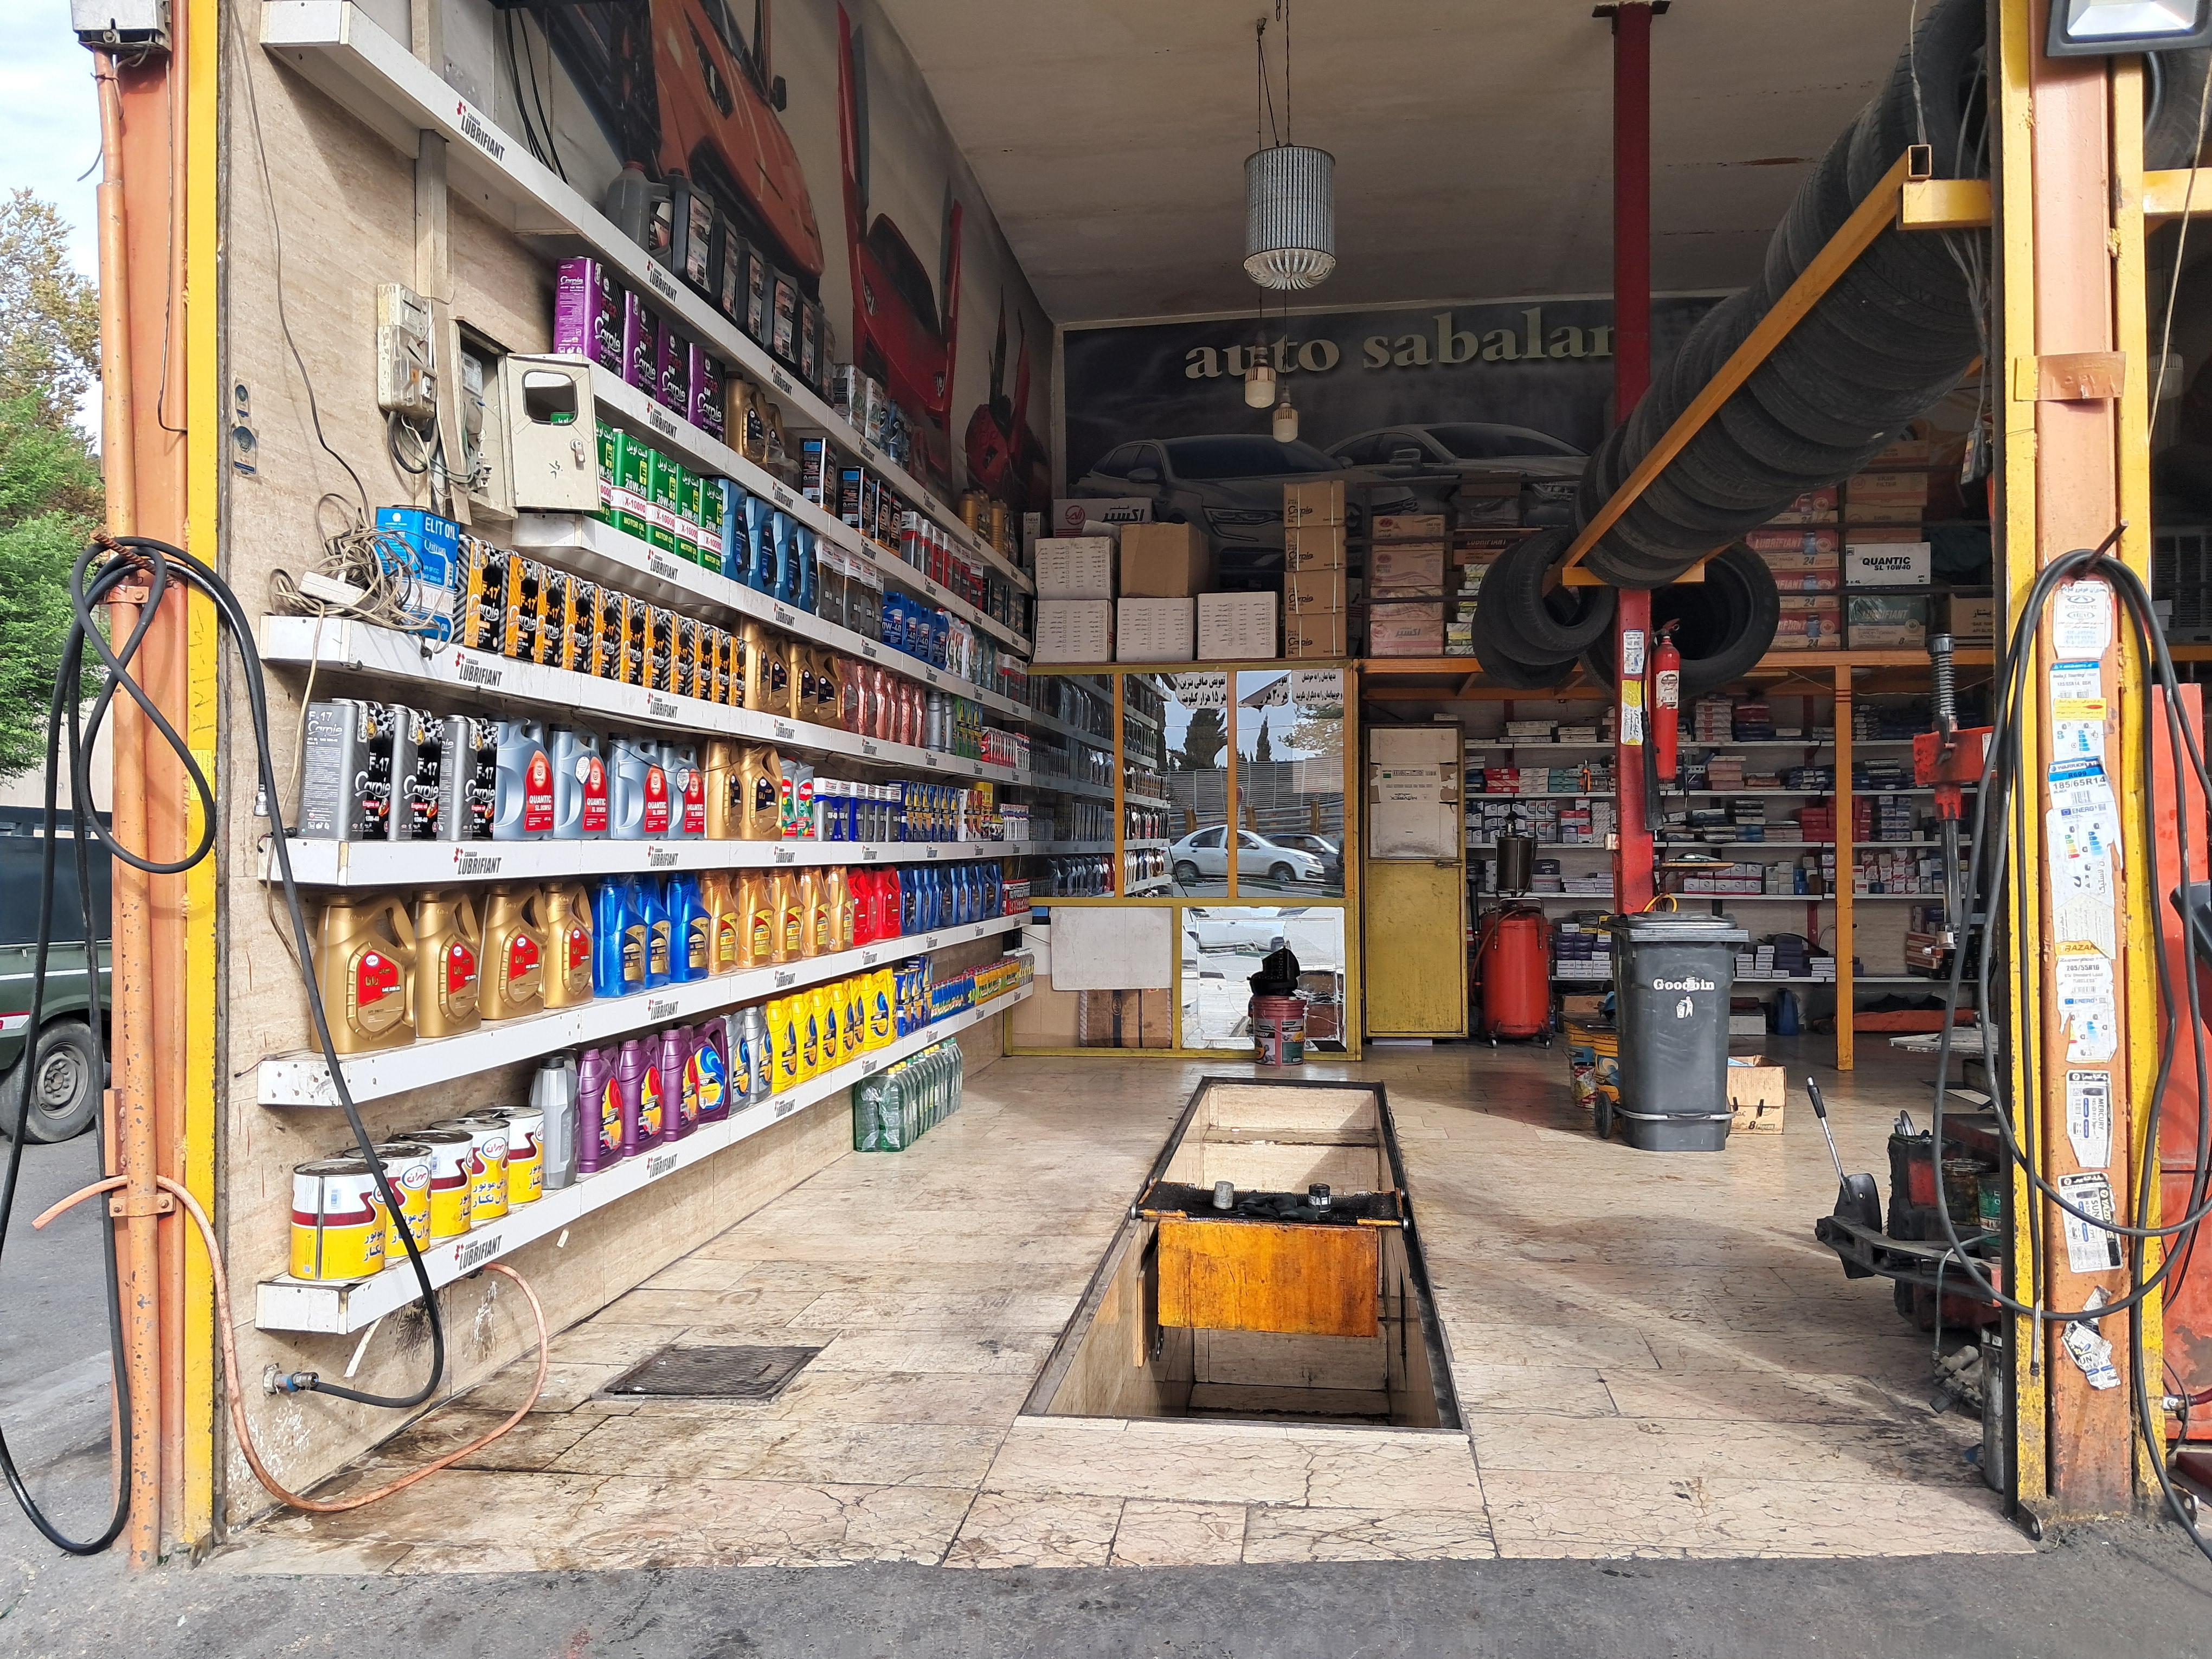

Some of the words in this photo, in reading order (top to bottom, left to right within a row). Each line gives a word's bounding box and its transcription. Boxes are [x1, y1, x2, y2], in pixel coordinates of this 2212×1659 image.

[461, 114, 505, 161] LUBRIFIANT
[650, 272, 677, 301] LUBRIFIANT
[1184, 333, 1340, 380] auto
[650, 412, 677, 439] LUBRIFIANT
[599, 465, 612, 479] W-50
[625, 478, 647, 497] 20W-50
[625, 497, 645, 513] X-10000
[657, 494, 675, 510] 20W-50
[656, 510, 674, 527] X-10000
[1102, 509, 1144, 522] اکسیر
[425, 517, 444, 536] ELIT
[445, 523, 456, 541] OIL
[624, 517, 638, 529] MOTOR
[655, 530, 668, 541] MOTOR
[1755, 537, 1804, 549] LUBRIFIANT
[1803, 556, 1815, 565] 24
[1862, 557, 1911, 565] QUANTIC
[651, 555, 678, 581] LUBRIFIANT
[469, 593, 499, 621] Carpie
[1804, 598, 1815, 607] 24
[1808, 639, 1818, 647] 24
[459, 663, 503, 686] LUBRIFIANT
[1180, 678, 1193, 689] بنزین
[1194, 676, 1208, 689] صافی
[1209, 676, 1225, 688] تعویض
[1199, 691, 1211, 705] هزار
[1212, 691, 1218, 702] ۱۵
[1220, 693, 1226, 704] هر
[1272, 689, 1279, 700] ۳۰
[308, 711, 333, 722] F-17
[650, 702, 678, 719] LUBRIFIANT
[307, 720, 343, 736] Carpie
[369, 757, 389, 772] F-17
[417, 762, 437, 776] F-17
[476, 767, 494, 780] F-17
[355, 771, 390, 800] Carpie
[403, 775, 439, 802] Carpie
[2053, 776, 2106, 789] 185/65R14
[465, 779, 495, 802] Carpie
[529, 795, 551, 805] QUANTIC
[587, 798, 606, 806] QUANTIC
[458, 857, 501, 874] LUBRIFIANT
[651, 853, 679, 866] LUBRIFIANT
[651, 1001, 679, 1020] LUBRIFIANT
[1748, 1121, 1755, 1130] 8
[486, 1143, 504, 1153] بهران
[650, 1154, 678, 1178] LUBRIFIANT
[407, 1172, 427, 1182] بهران
[473, 1180, 496, 1193] موتور
[472, 1194, 494, 1207] تکتاز
[2091, 1200, 2101, 1217] SUN
[2101, 1199, 2111, 1220] YAZD
[459, 1236, 502, 1270] LUBRIFIANT
